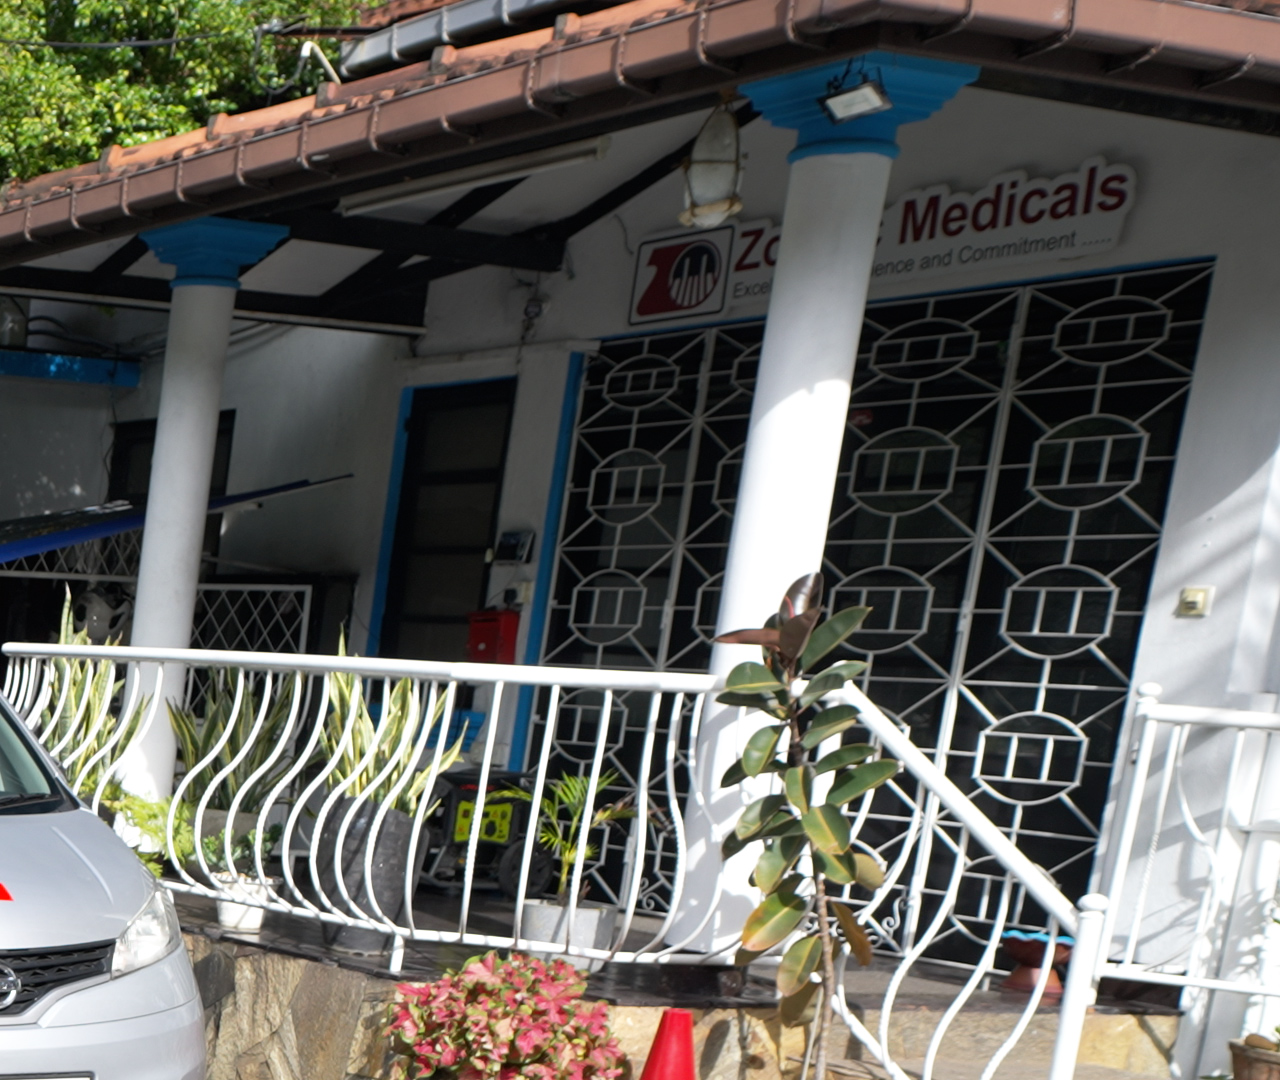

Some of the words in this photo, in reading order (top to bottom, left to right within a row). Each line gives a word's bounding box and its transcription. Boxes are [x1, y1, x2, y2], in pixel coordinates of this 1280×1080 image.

[898, 165, 1130, 245] Medicals
[919, 251, 953, 272] and
[957, 231, 1077, 264] Commitment
